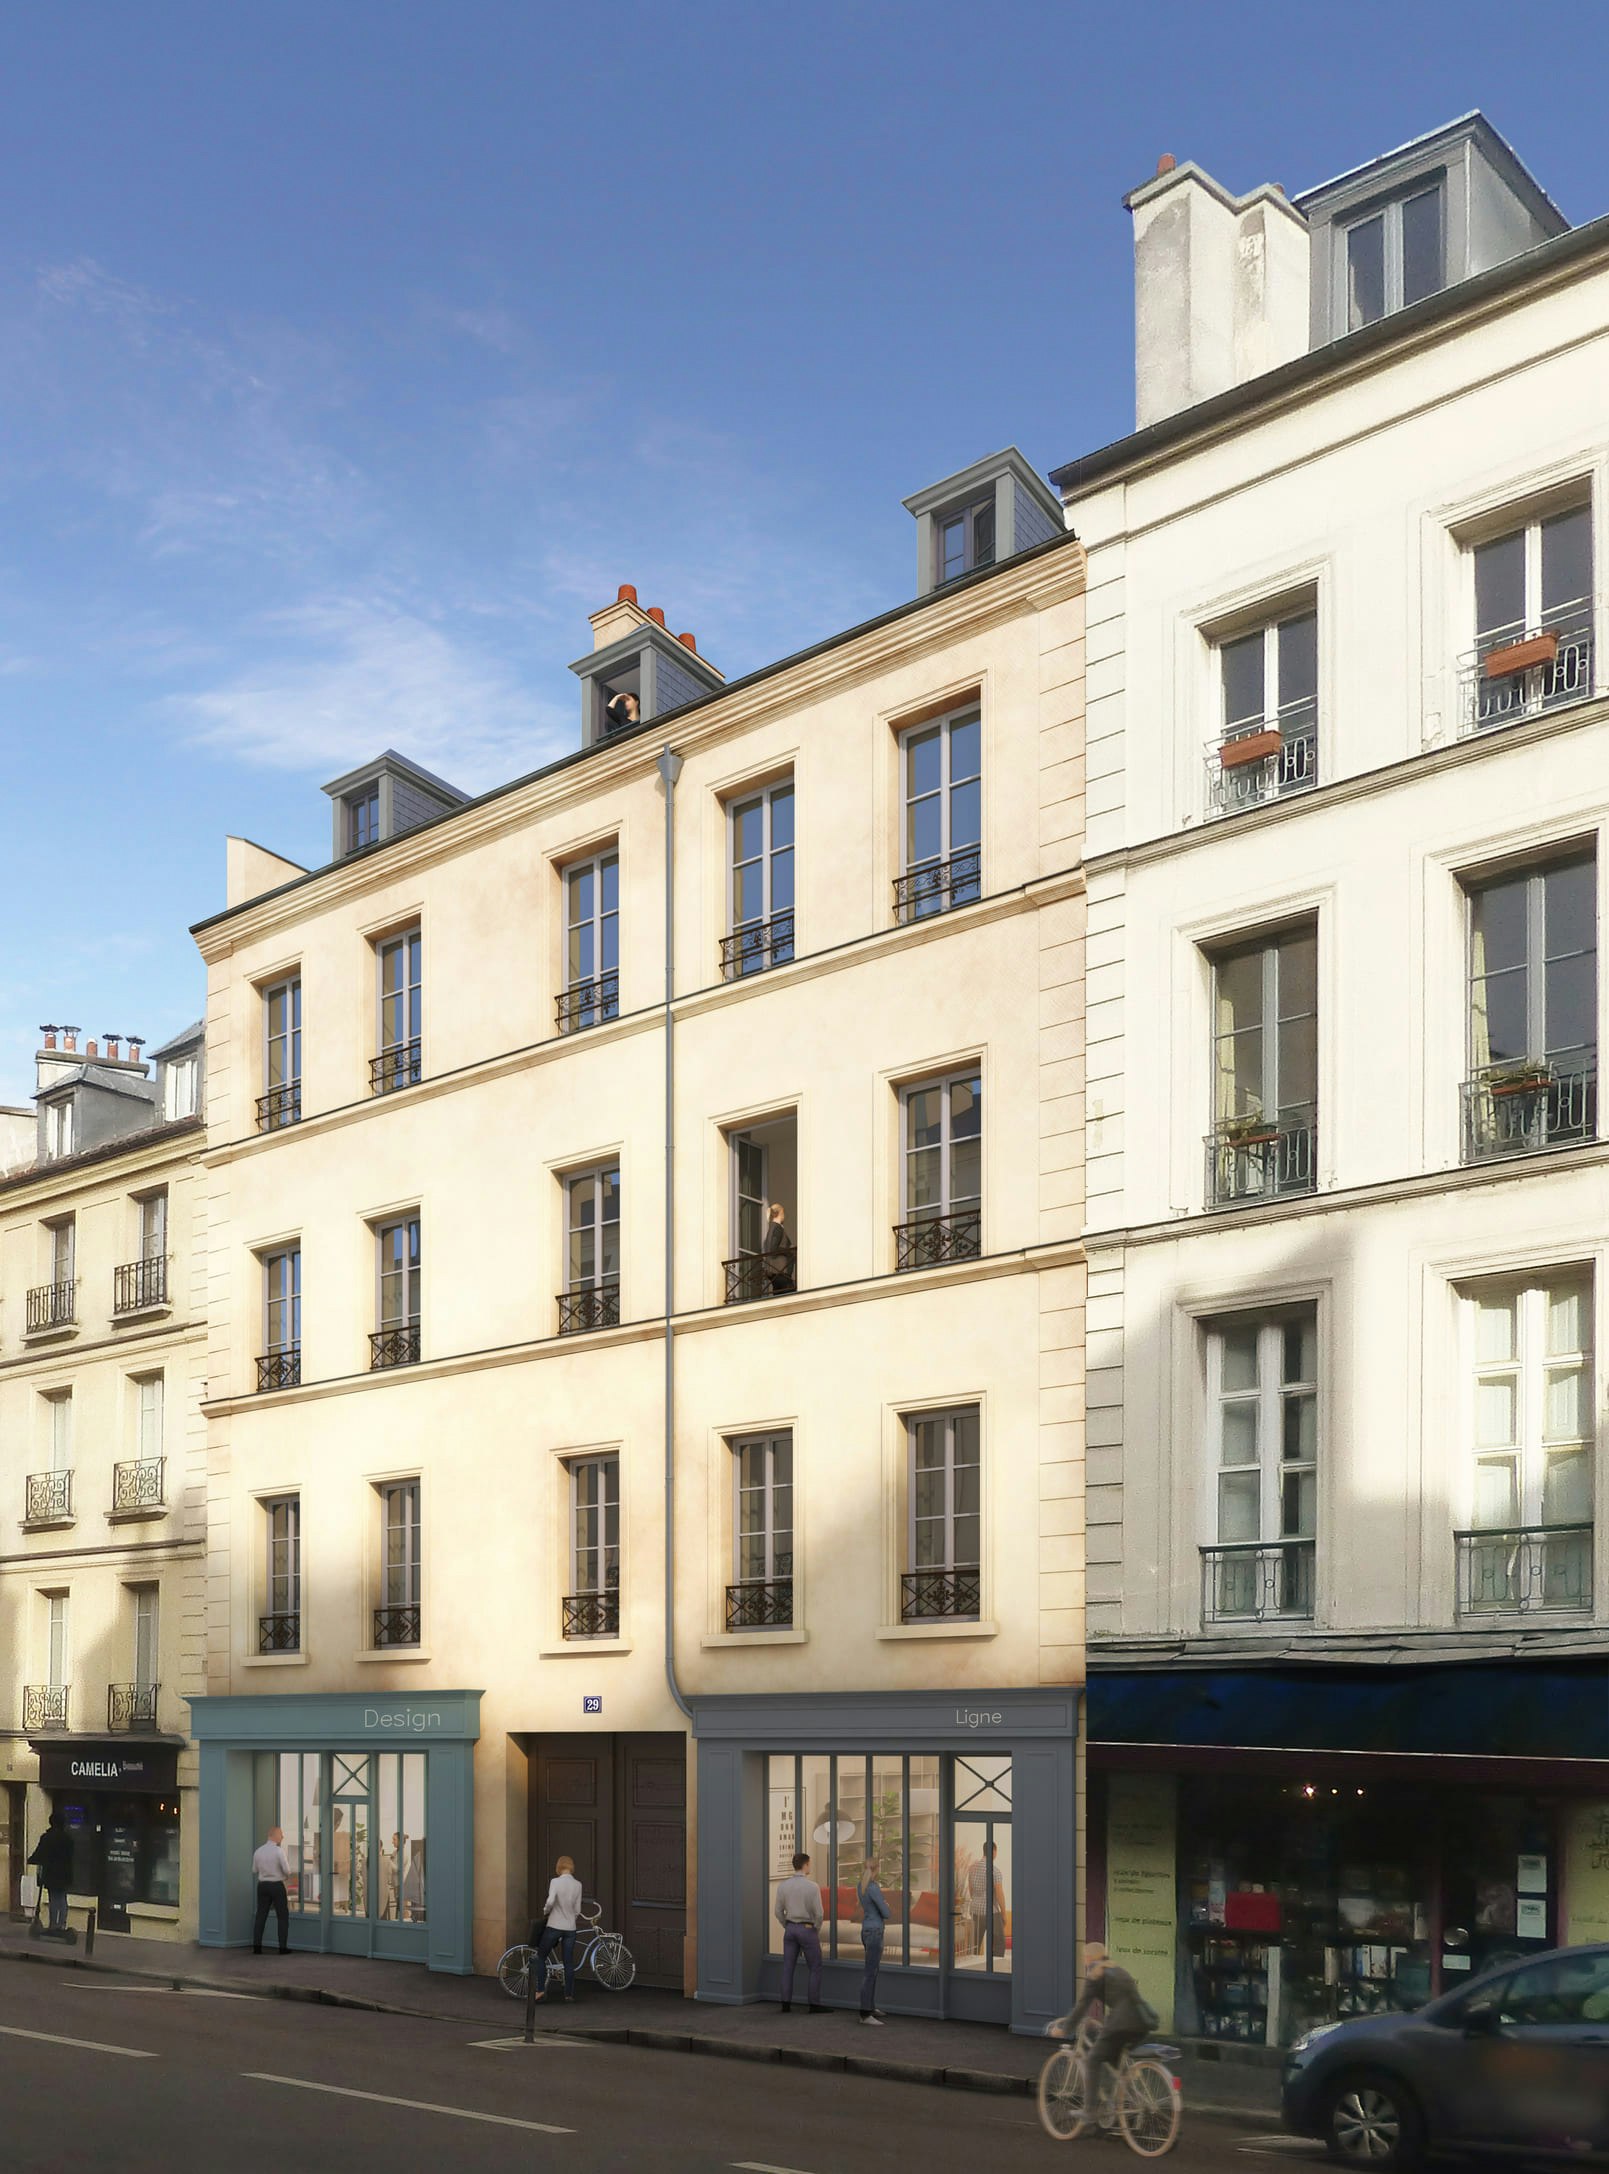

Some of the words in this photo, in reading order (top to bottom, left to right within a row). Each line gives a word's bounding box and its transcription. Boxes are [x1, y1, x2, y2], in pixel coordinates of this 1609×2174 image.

[586, 1698, 599, 1711] 29
[364, 1708, 441, 1732] Design
[956, 1708, 1002, 1729] Ligne
[71, 1761, 118, 1777] CAMELIA
